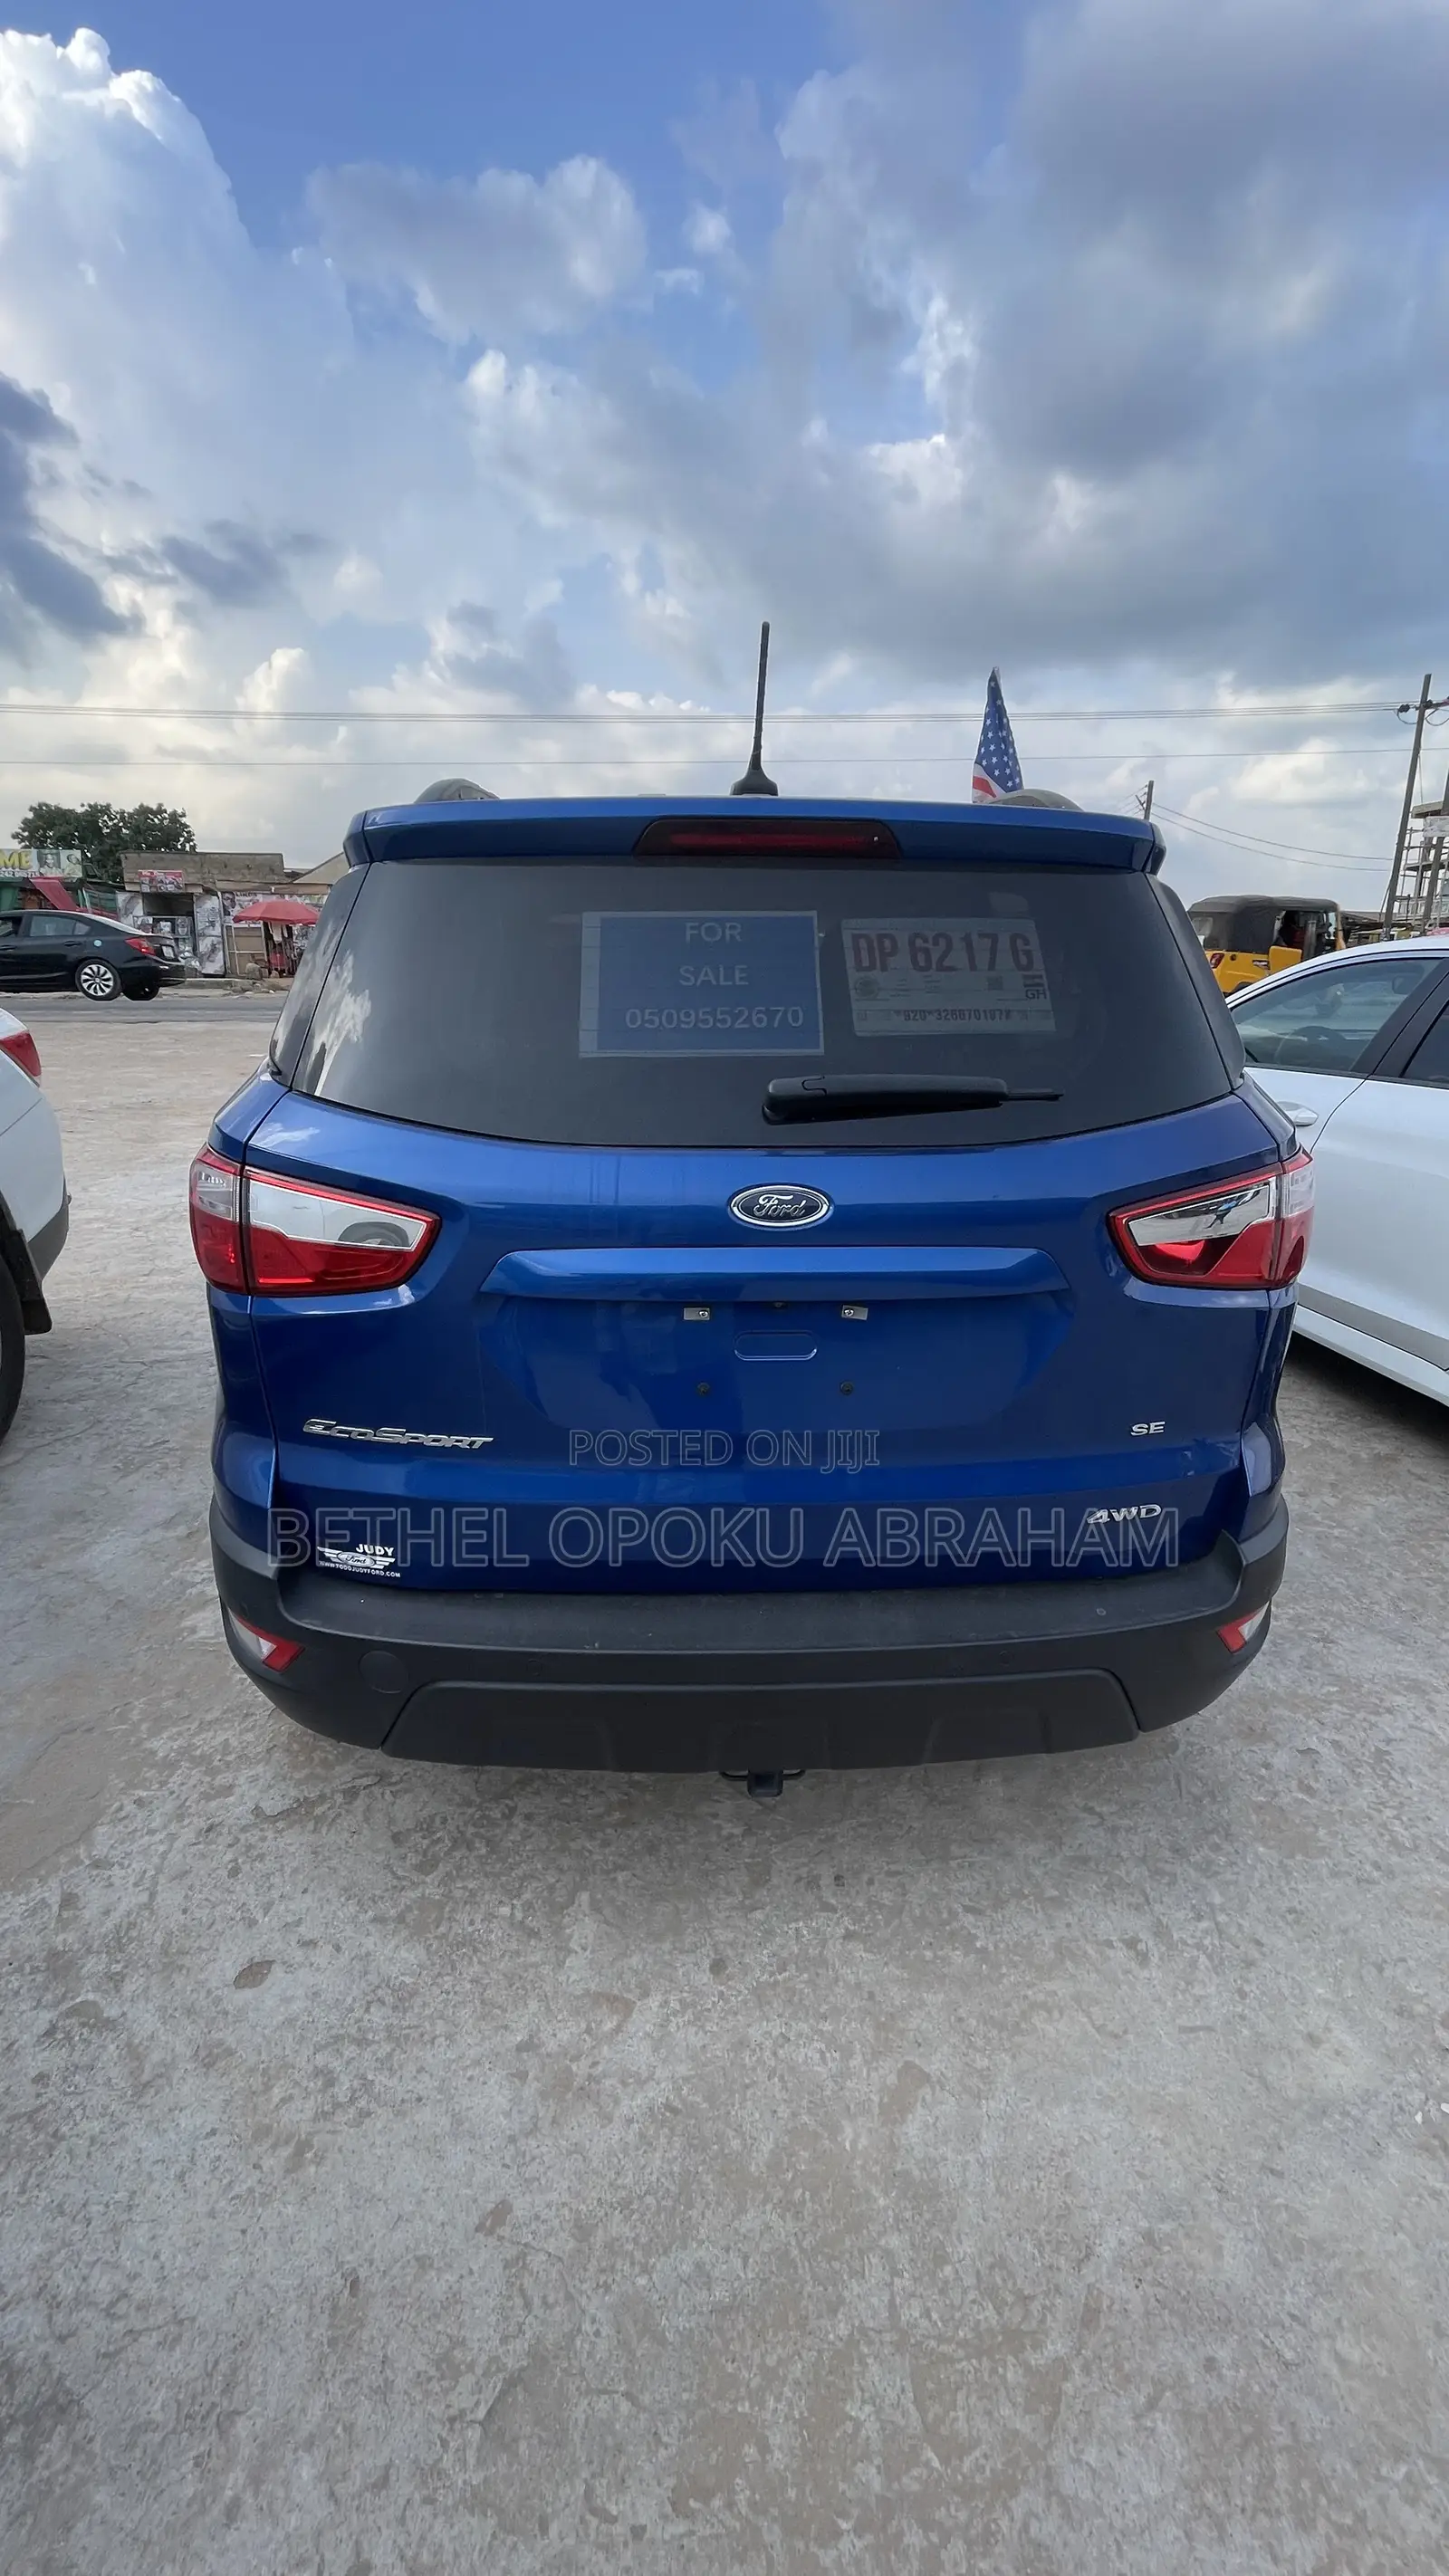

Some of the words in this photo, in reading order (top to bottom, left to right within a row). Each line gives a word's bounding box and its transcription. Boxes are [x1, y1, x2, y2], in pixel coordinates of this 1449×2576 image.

[685, 922, 743, 943] FOR
[851, 933, 898, 972] DP
[908, 932, 999, 972] 6217
[1009, 932, 1034, 972] G
[679, 965, 749, 986] SALE
[625, 1007, 804, 1029] 0509552670
[753, 1194, 807, 1217] Ford
[1130, 1421, 1166, 1436] SE
[1087, 1504, 1163, 1524] 4WD
[355, 1543, 395, 1556] JUDY
